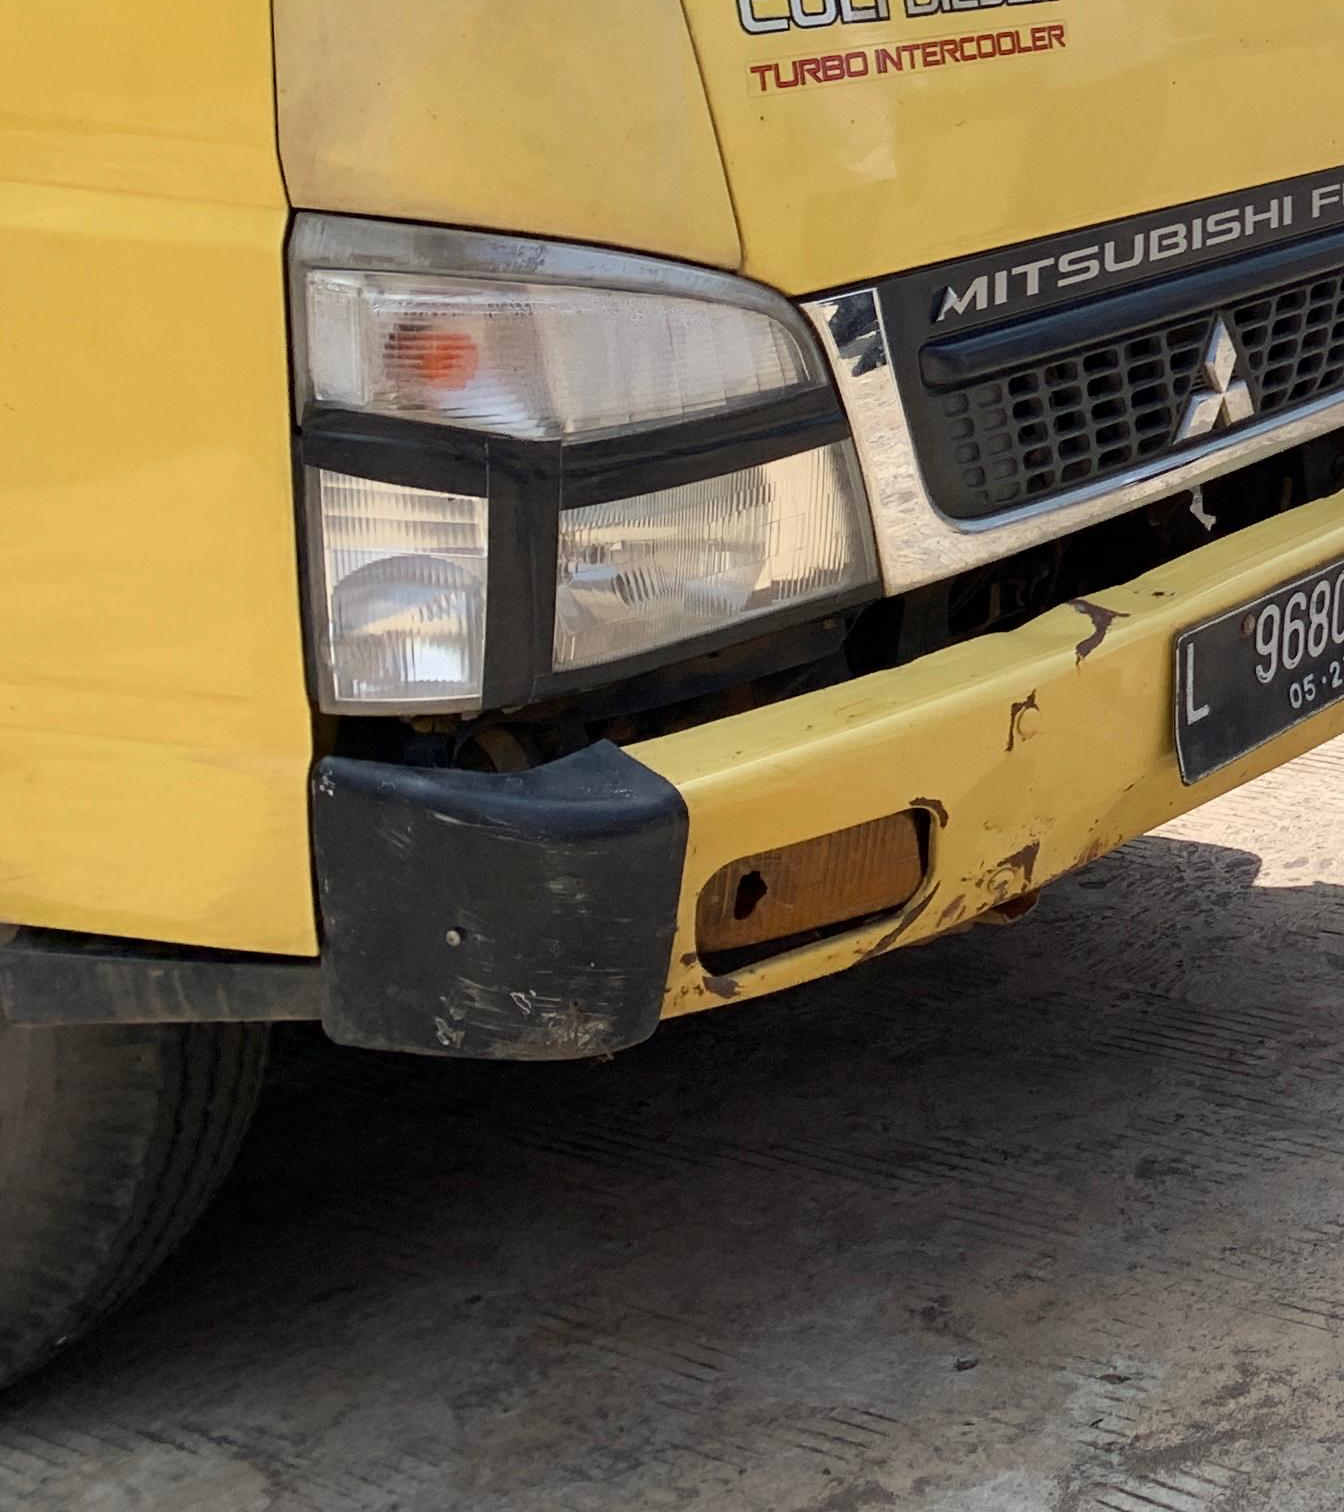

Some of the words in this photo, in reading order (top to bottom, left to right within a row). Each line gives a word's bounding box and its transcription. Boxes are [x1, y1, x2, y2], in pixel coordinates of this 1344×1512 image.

[750, 51, 868, 92] TURBO
[875, 24, 1066, 74] INTERCOOLER
[935, 194, 1293, 321] MITSUBISHI
[1186, 643, 1210, 725] L
